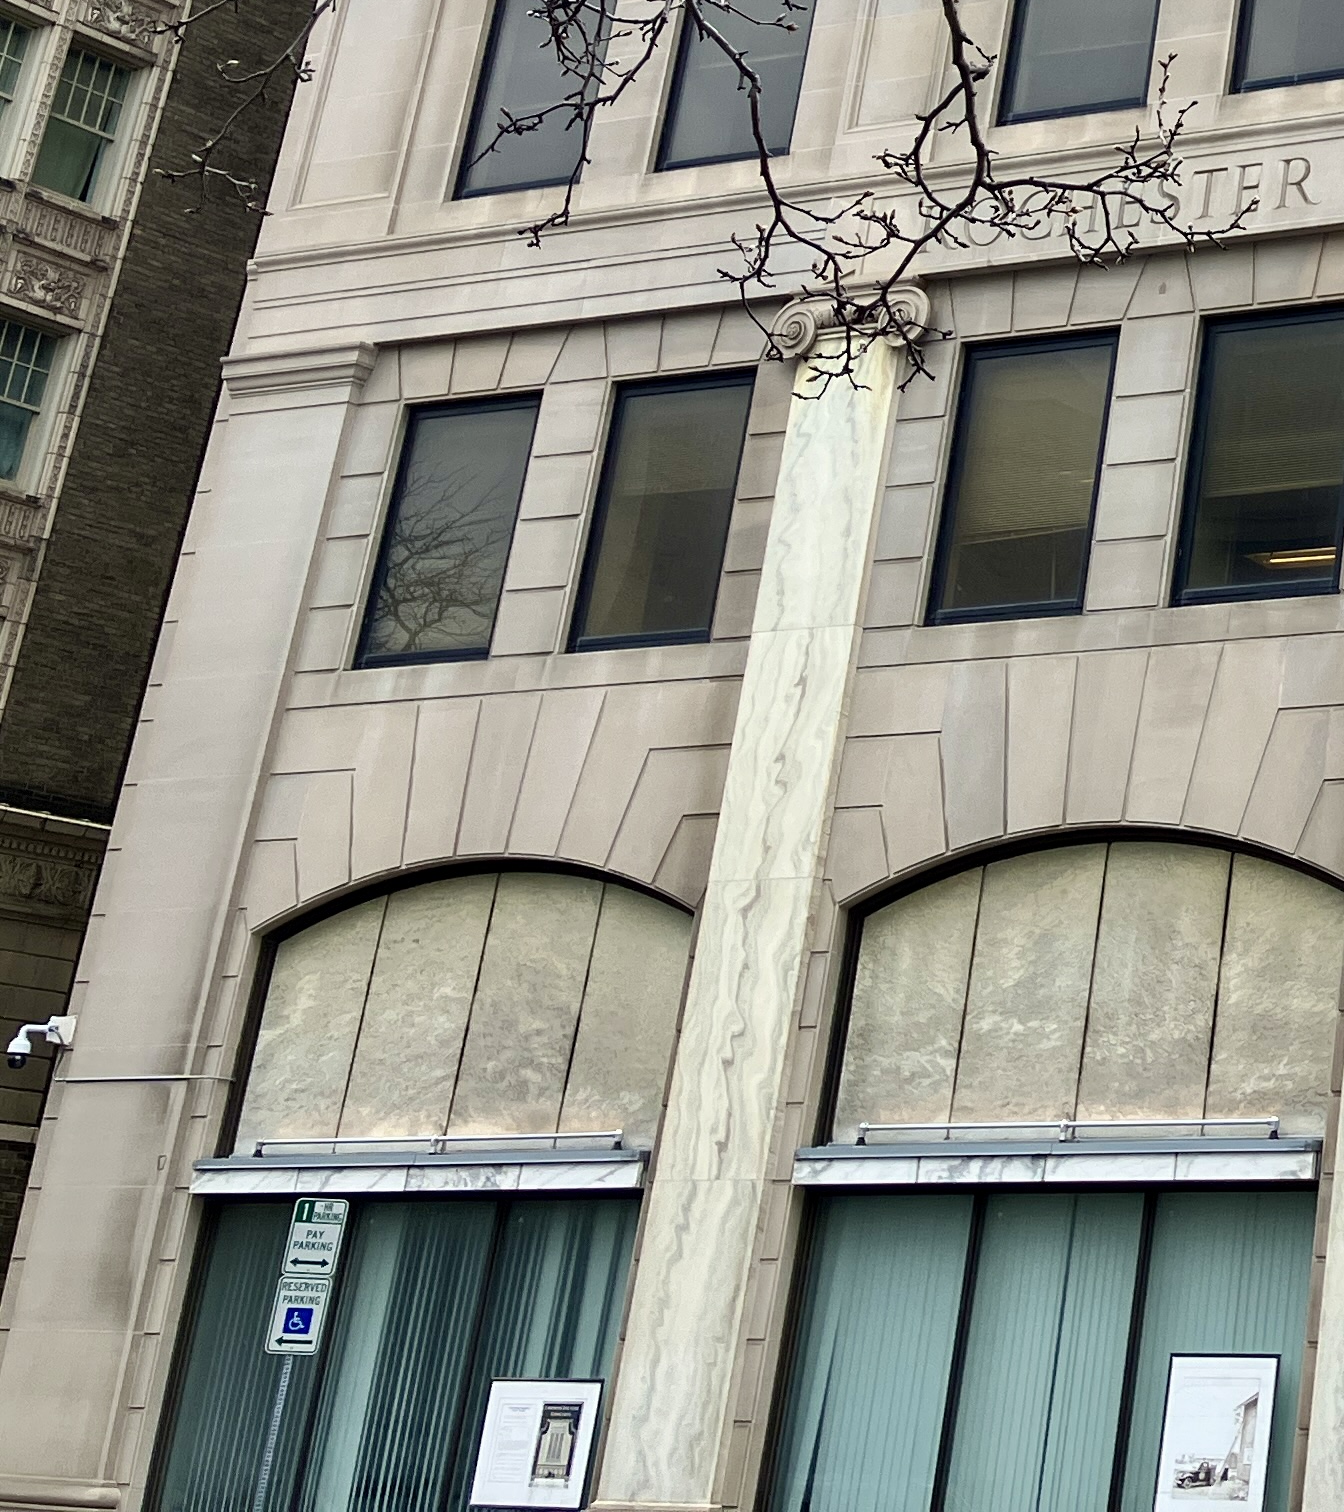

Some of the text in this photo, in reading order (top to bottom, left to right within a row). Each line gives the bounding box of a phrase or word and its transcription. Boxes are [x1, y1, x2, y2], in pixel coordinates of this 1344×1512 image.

[302, 1203, 309, 1221] 1
[313, 1212, 342, 1221] PARKING
[306, 1230, 325, 1239] PAY
[293, 1241, 333, 1251] PARKING
[282, 1282, 327, 1292] RESERVED
[282, 1295, 321, 1305] PARKING
